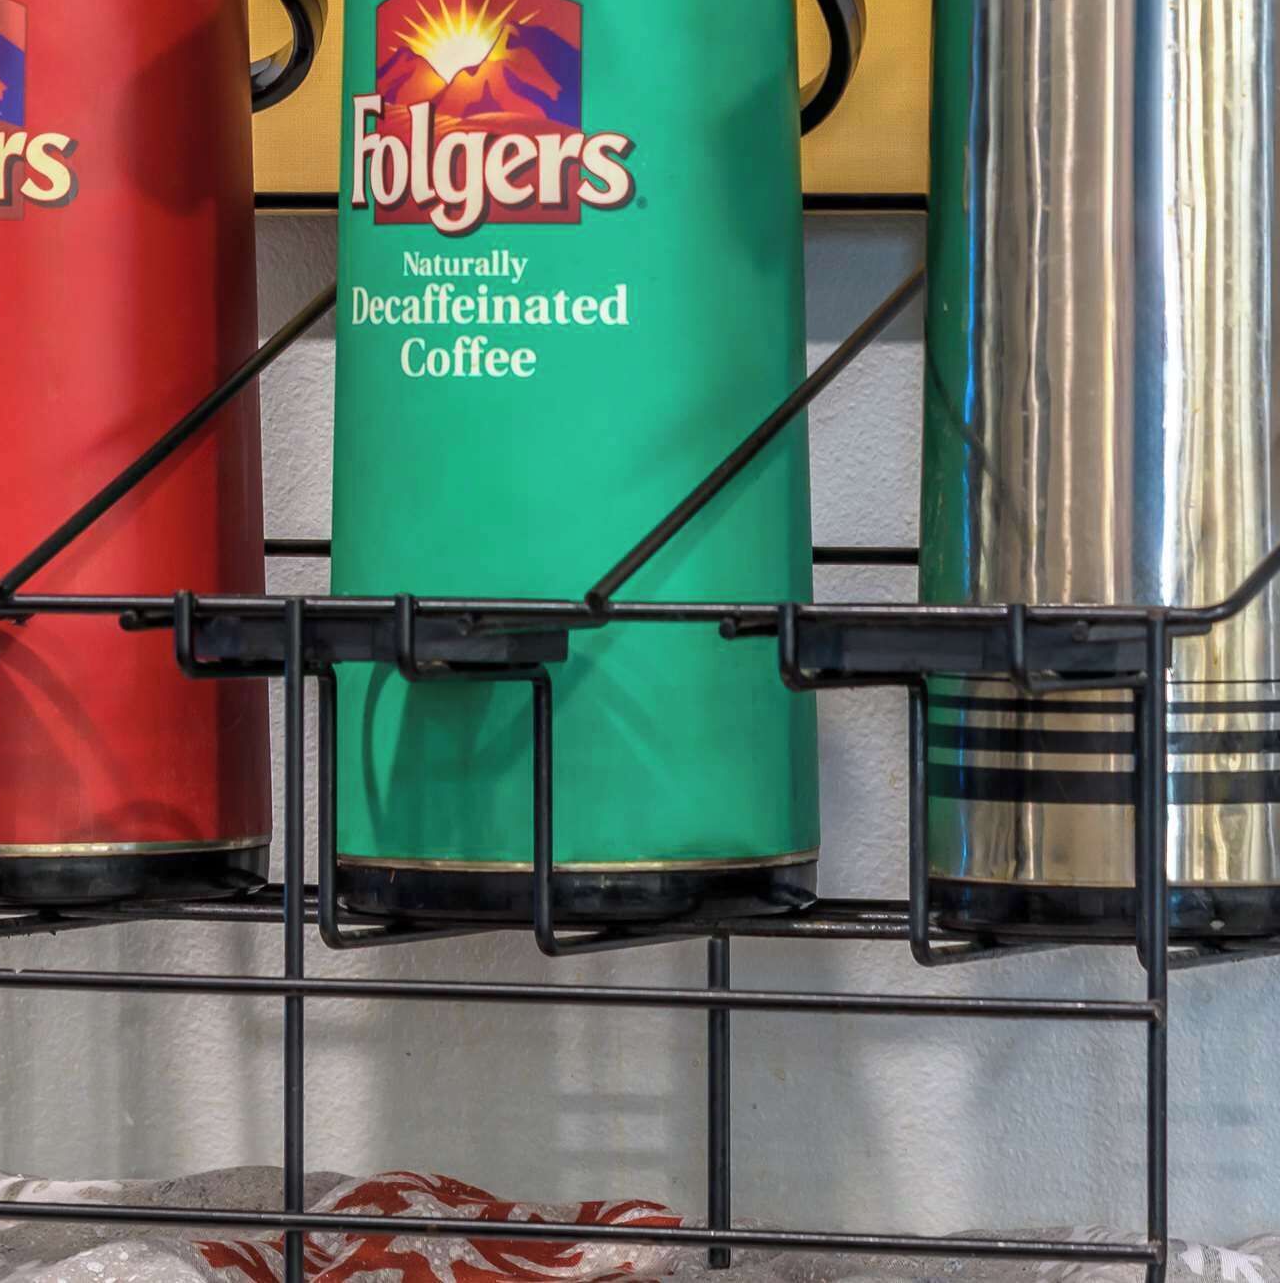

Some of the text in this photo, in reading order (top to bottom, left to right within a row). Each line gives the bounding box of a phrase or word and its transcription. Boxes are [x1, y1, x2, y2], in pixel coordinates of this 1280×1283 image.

[351, 93, 634, 235] Folgers
[403, 250, 528, 283] Naturally
[351, 284, 630, 326] Decaffeinated
[400, 337, 537, 378] Coffee
